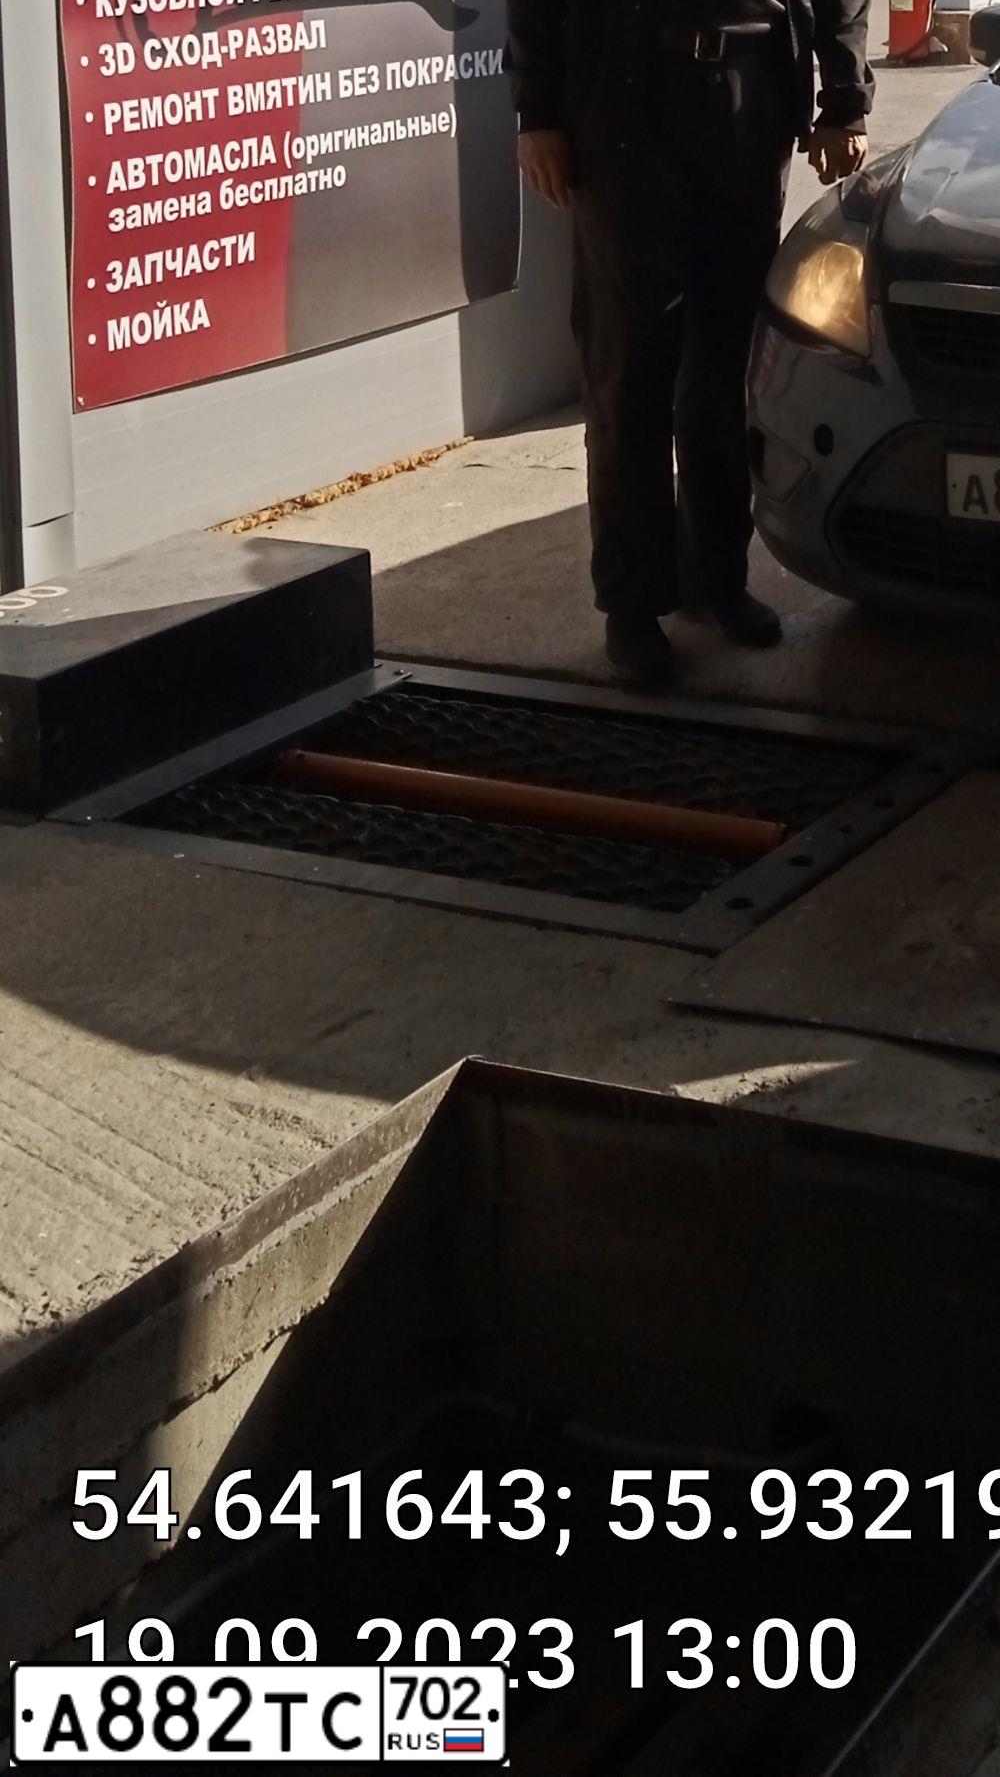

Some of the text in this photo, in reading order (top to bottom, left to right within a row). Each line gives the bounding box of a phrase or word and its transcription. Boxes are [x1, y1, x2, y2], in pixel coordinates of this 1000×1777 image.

[99, 20, 327, 76] 3D СХОД-РАЗВАЛ
[104, 49, 504, 135] РЕМОНТ ВМЯТИН БЕЗ ПОКРАСКИ
[106, 104, 458, 194] АВТОМАСЛА (оригинальные)
[108, 164, 346, 233] замена бесплатно
[106, 232, 255, 294] ЗАПЧАСТИ
[107, 299, 210, 351] МОЙКА
